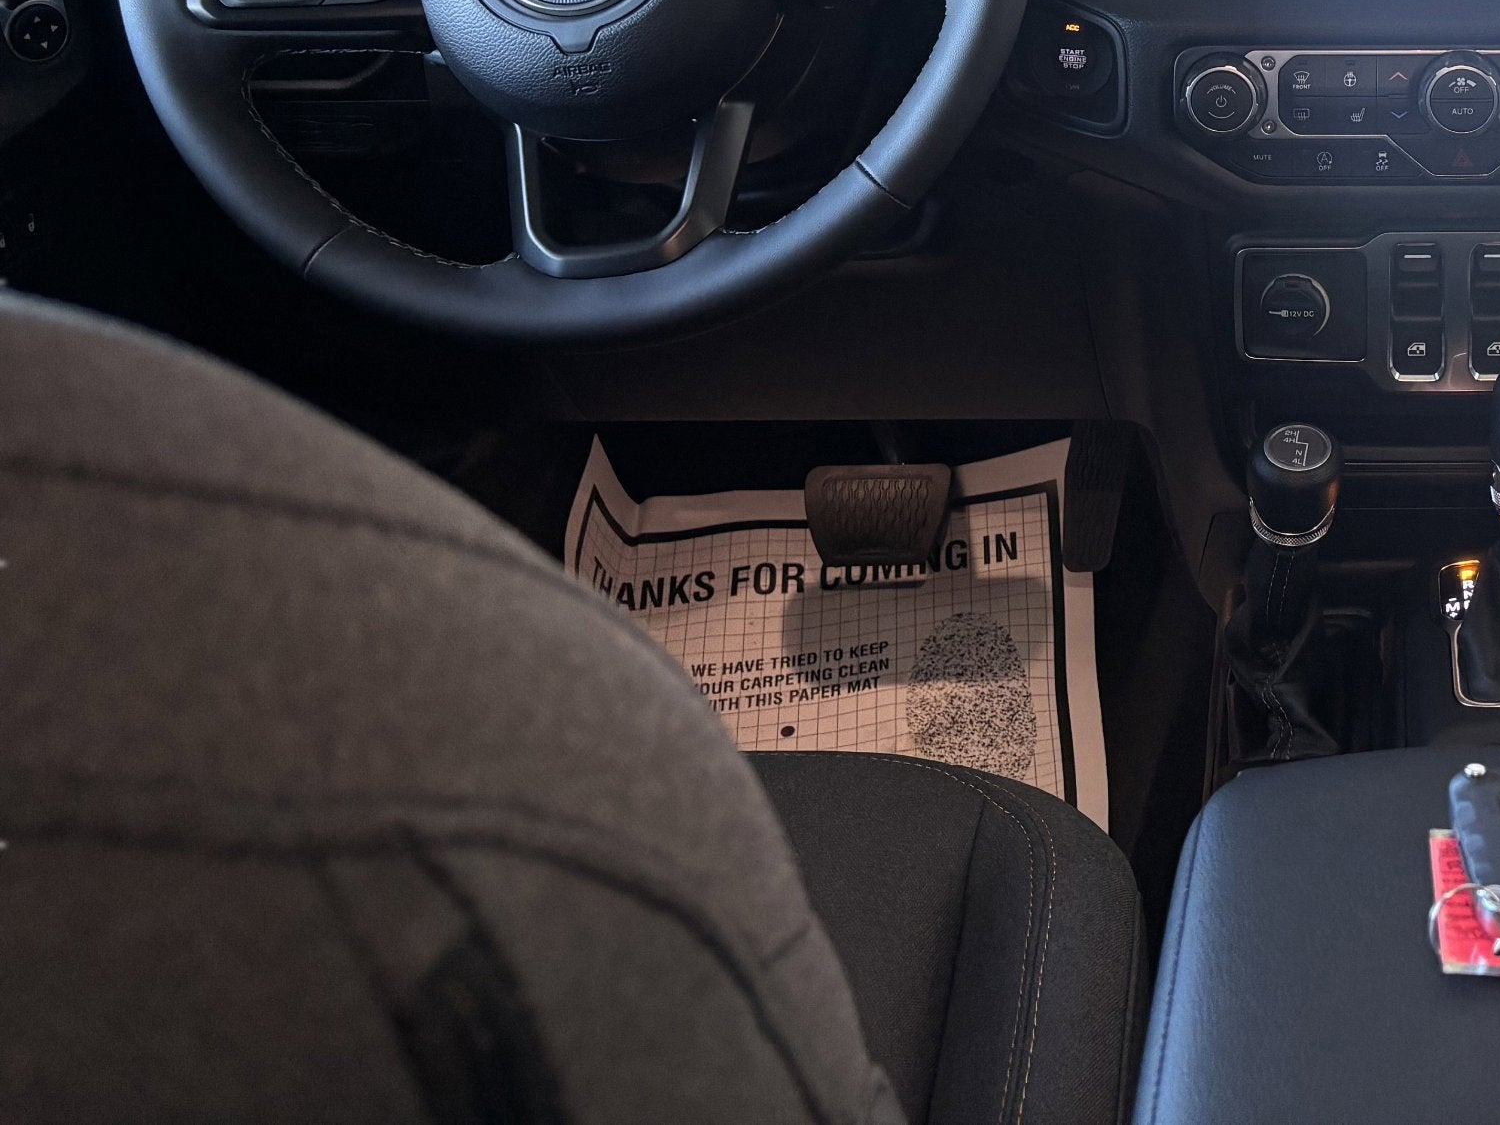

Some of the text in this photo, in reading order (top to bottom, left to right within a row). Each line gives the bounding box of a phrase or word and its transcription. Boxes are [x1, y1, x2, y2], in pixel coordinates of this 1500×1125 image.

[1059, 55, 1087, 63] ENGINE
[552, 62, 612, 76] AIRBAG
[1210, 84, 1234, 92] VOLUME
[1451, 108, 1474, 116] AUTO
[593, 556, 716, 612] THANKS
[730, 562, 805, 597] FOR
[983, 532, 1018, 565] IN
[1463, 580, 1475, 590] R
[1445, 601, 1460, 613] M
[691, 641, 889, 678] WE HAVE TRIED TO KEEP
[695, 658, 890, 696] OUR CARPETING CLEAN
[708, 676, 880, 712] ITH THIS PAPER MAT
